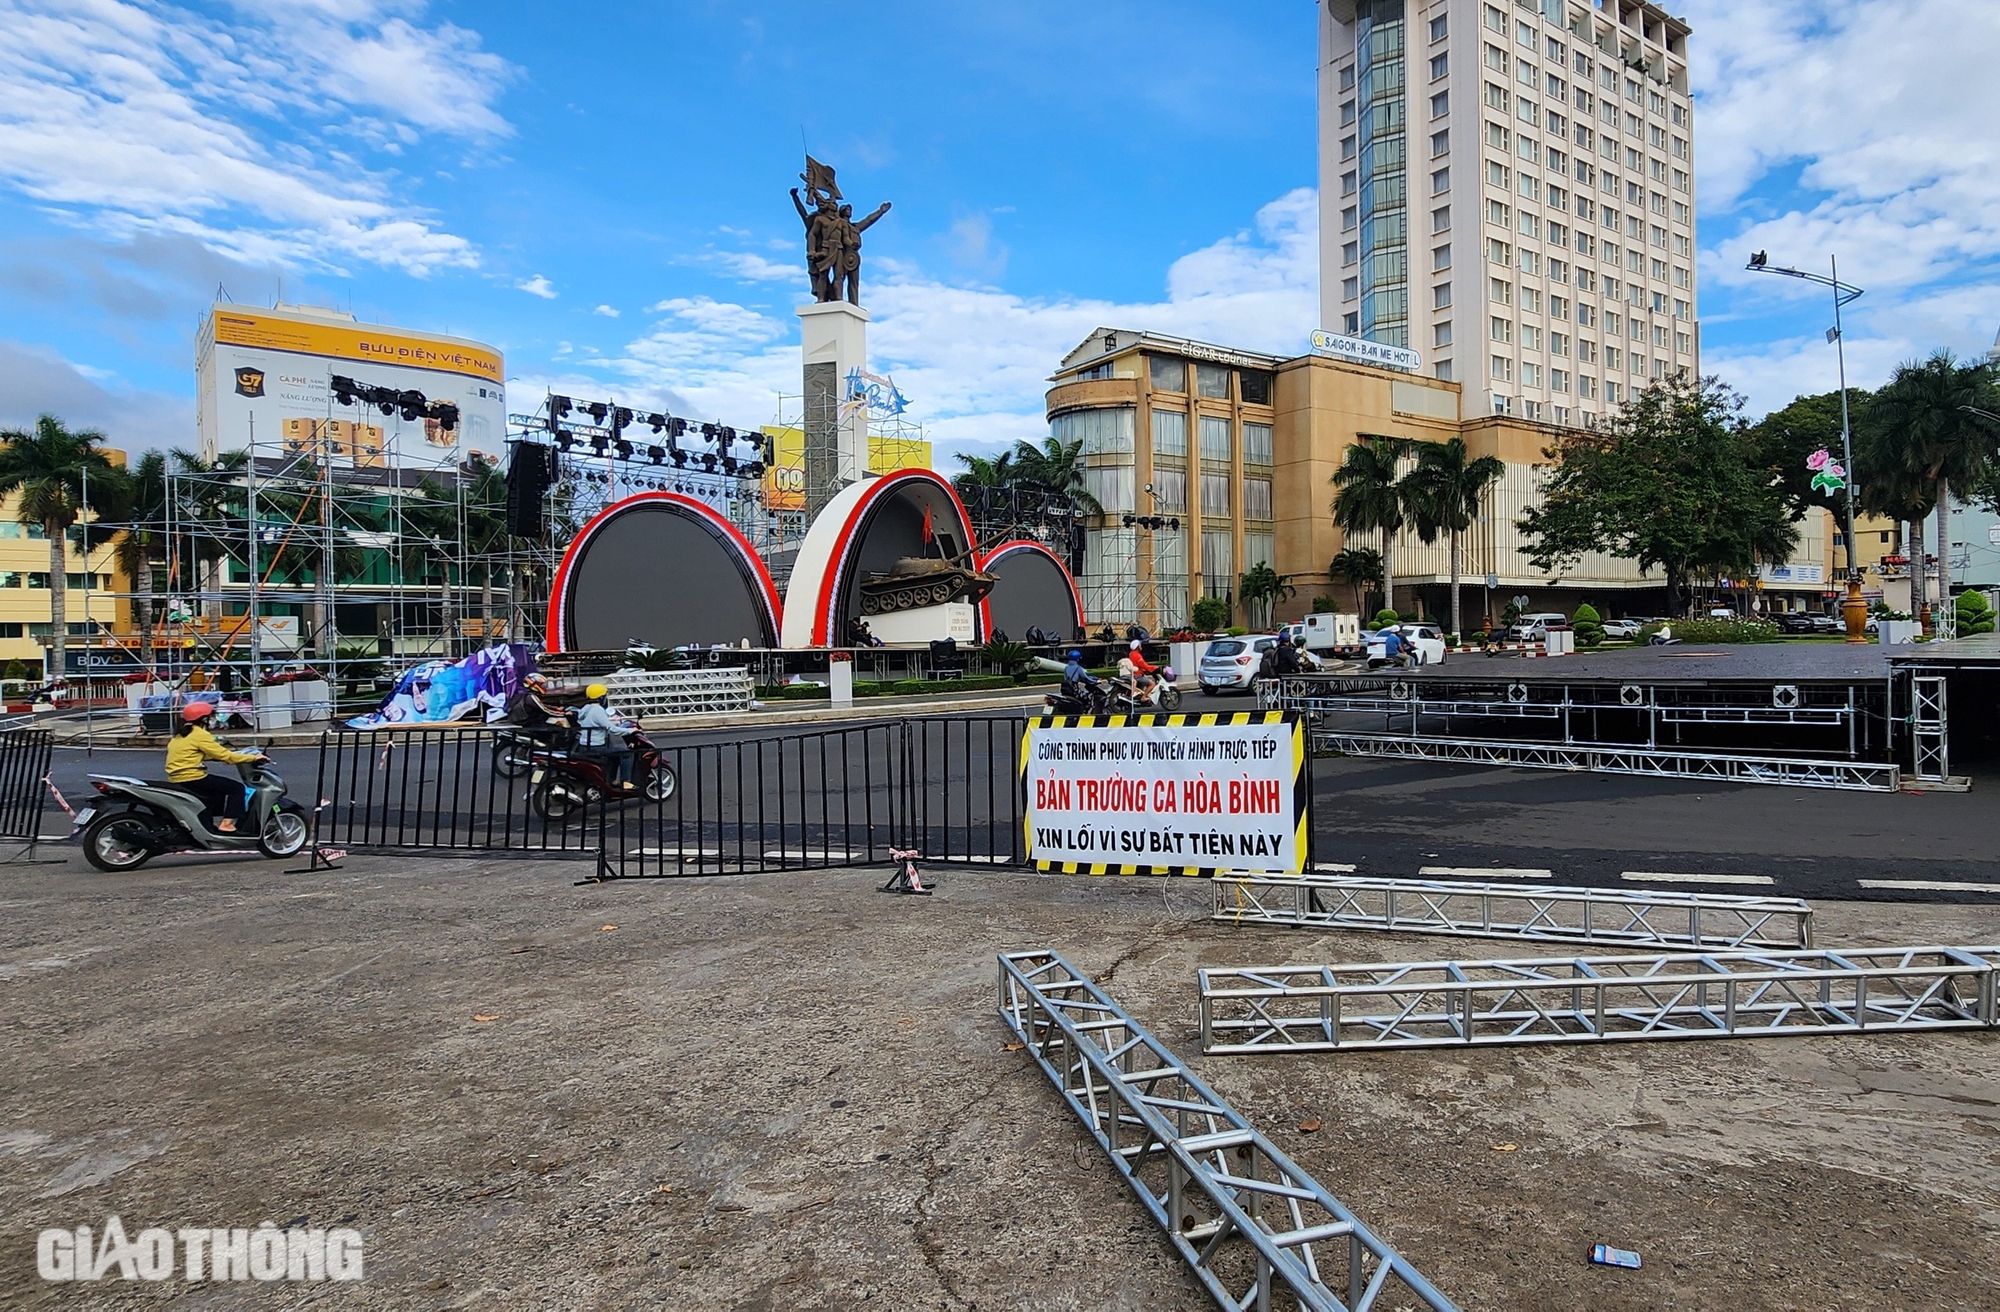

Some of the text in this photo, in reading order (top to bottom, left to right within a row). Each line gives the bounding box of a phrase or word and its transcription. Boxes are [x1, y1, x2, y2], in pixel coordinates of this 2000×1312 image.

[360, 342, 496, 370] BƯU ĐIỆN VIỆT NAM
[1181, 343, 1216, 361] CIGAR
[1325, 336, 1356, 353] SAIGON
[1361, 344, 1378, 357] BAN
[1380, 348, 1392, 360] ME
[1393, 350, 1419, 366] HOTL
[237, 373, 262, 387] G7
[77, 656, 111, 666] BDV
[1039, 738, 1063, 760] CÔNG
[1066, 738, 1096, 761] TRÌNH
[1100, 742, 1127, 765] PHỤC
[1130, 742, 1144, 765] VỤ
[1188, 737, 1215, 760] HÌNH
[1219, 738, 1247, 764] TRỰC
[1252, 733, 1277, 760] TIẾP
[1036, 768, 1280, 814] BẢN TRƯỜNG CA HÒA BÌNH
[1036, 823, 1283, 859] XIN LỖI VÌ SỰ BẤT TIỆN NÀY
